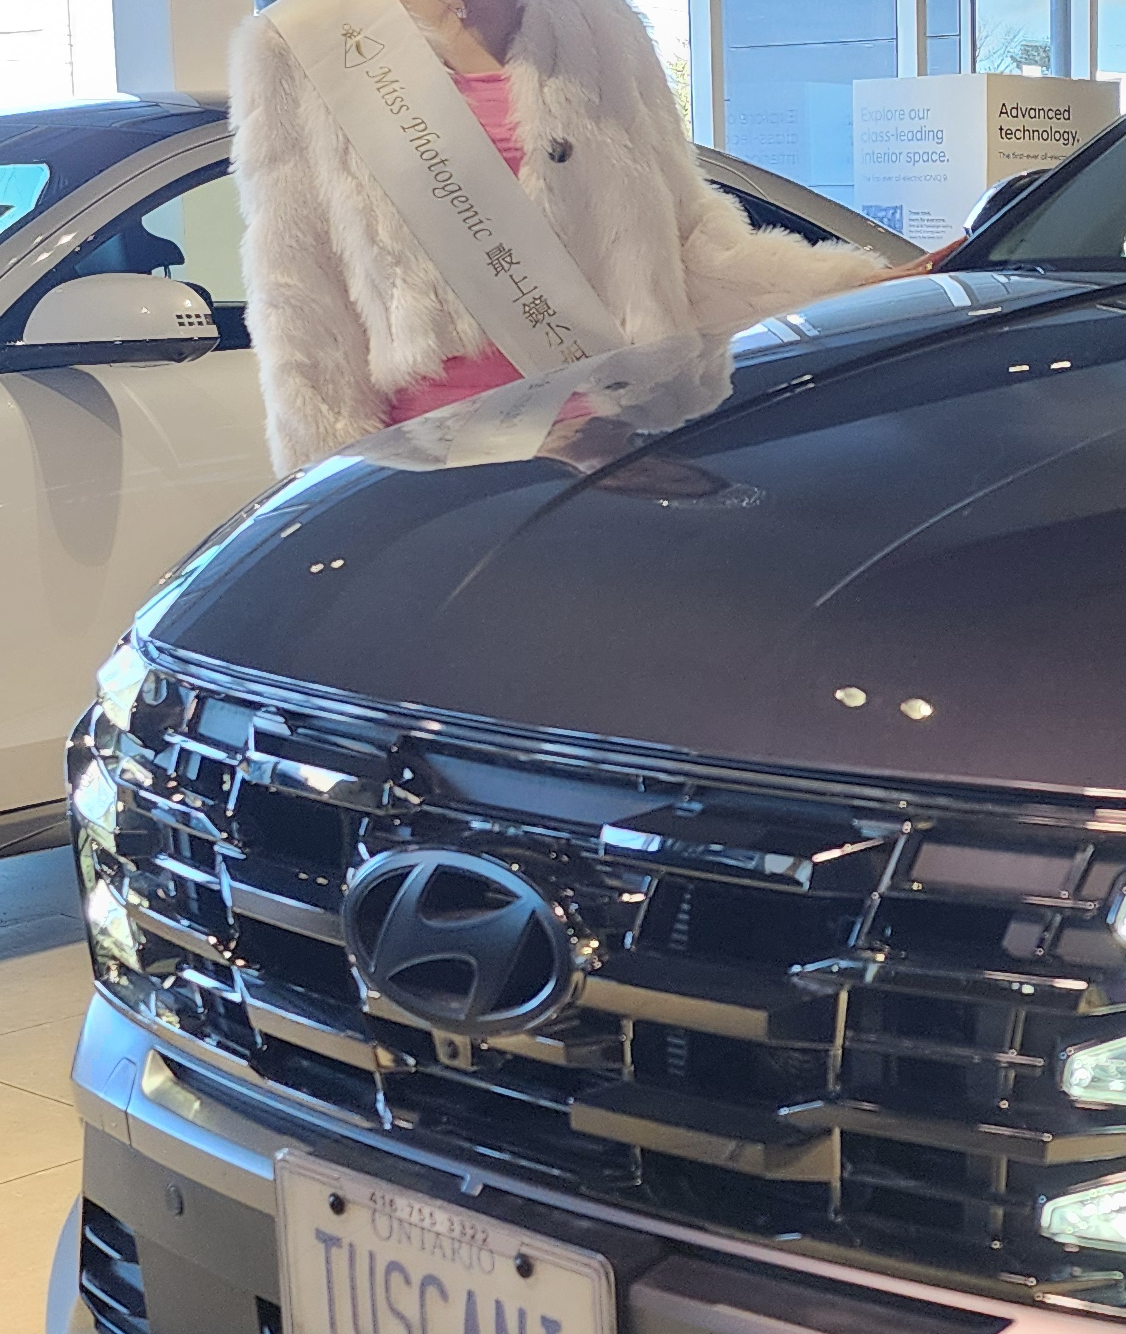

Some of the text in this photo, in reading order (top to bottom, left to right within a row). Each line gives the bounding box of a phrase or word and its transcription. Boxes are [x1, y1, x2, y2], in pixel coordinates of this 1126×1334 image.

[861, 107, 931, 124] Explore our
[998, 102, 1071, 121] Advanced
[861, 125, 944, 145] class-leading
[998, 125, 1080, 146] technology.
[366, 66, 409, 115] Miss
[400, 117, 493, 241] Photogenic
[862, 148, 950, 167] interior space.
